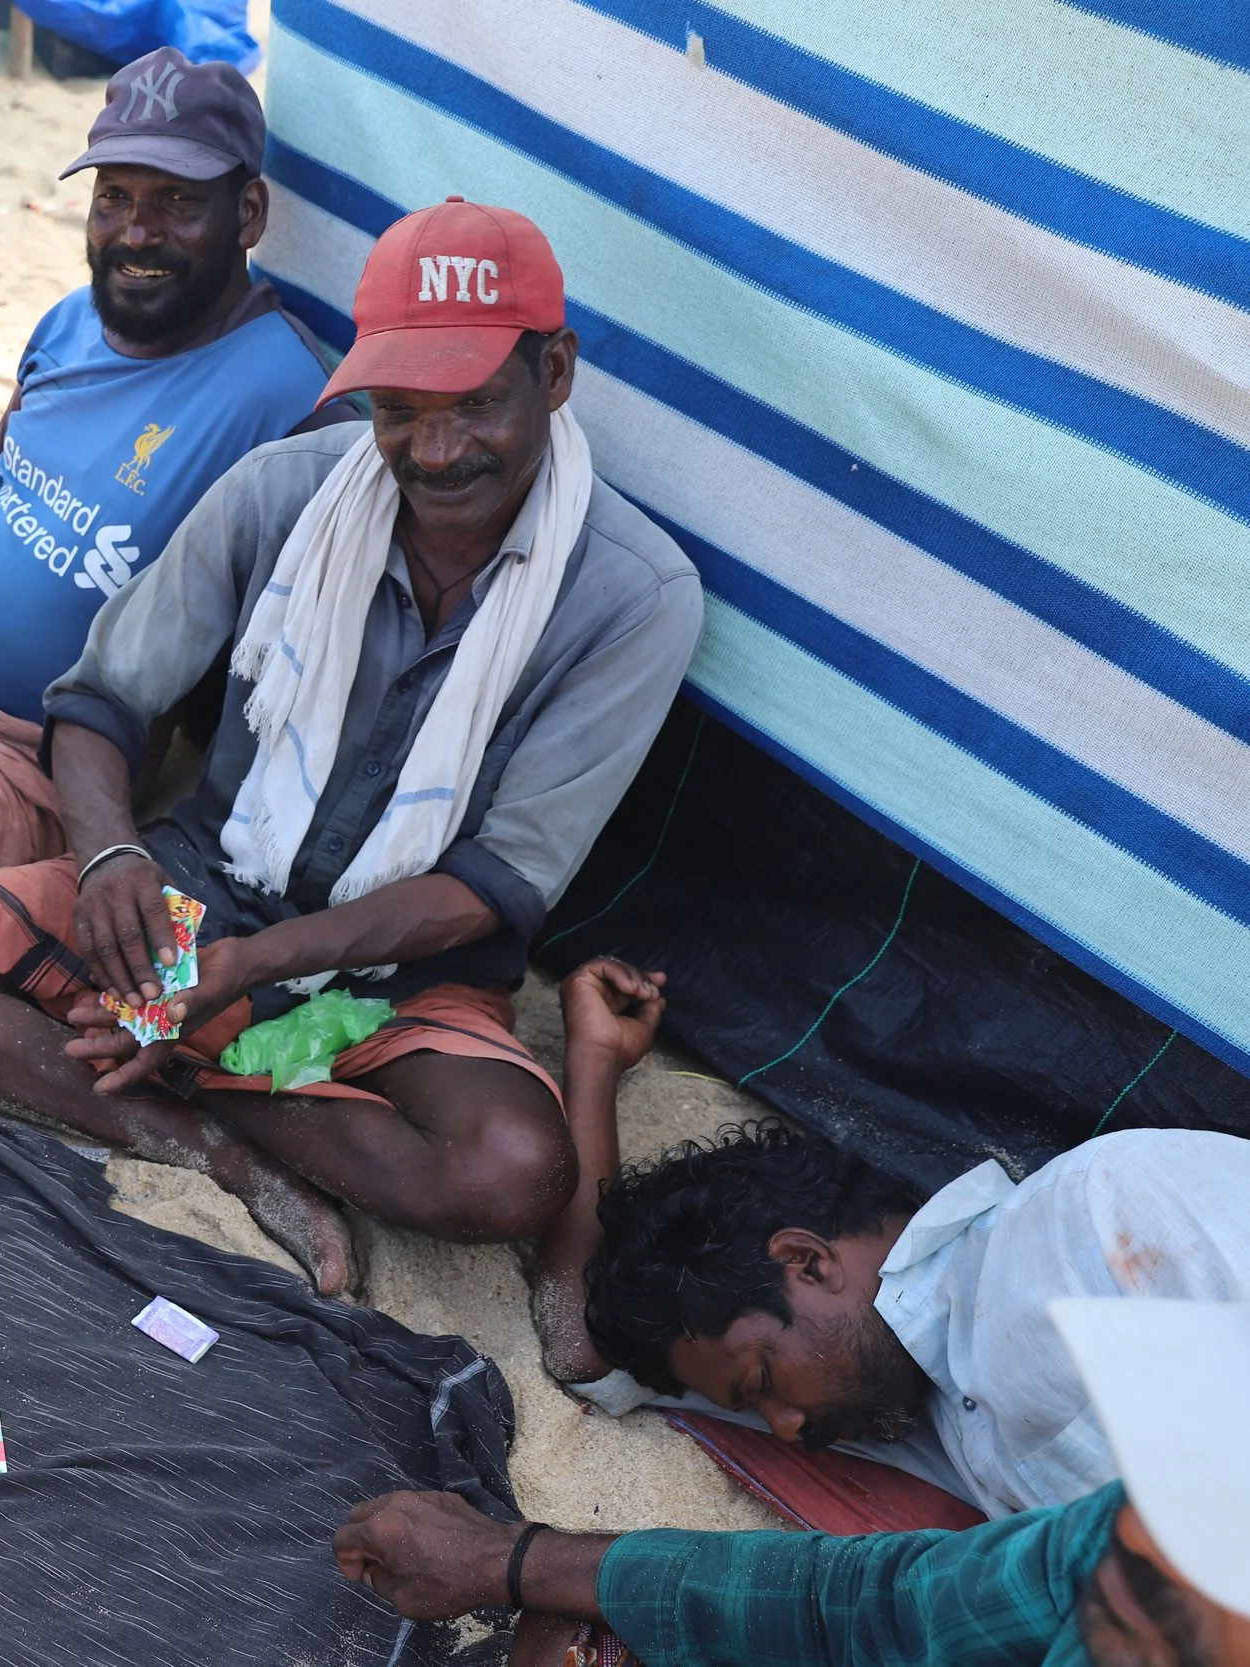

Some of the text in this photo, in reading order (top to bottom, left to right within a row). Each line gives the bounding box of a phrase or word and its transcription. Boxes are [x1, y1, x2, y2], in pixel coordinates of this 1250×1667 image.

[120, 61, 185, 123] NY
[419, 255, 498, 304] NYC
[4, 436, 100, 535] Standard
